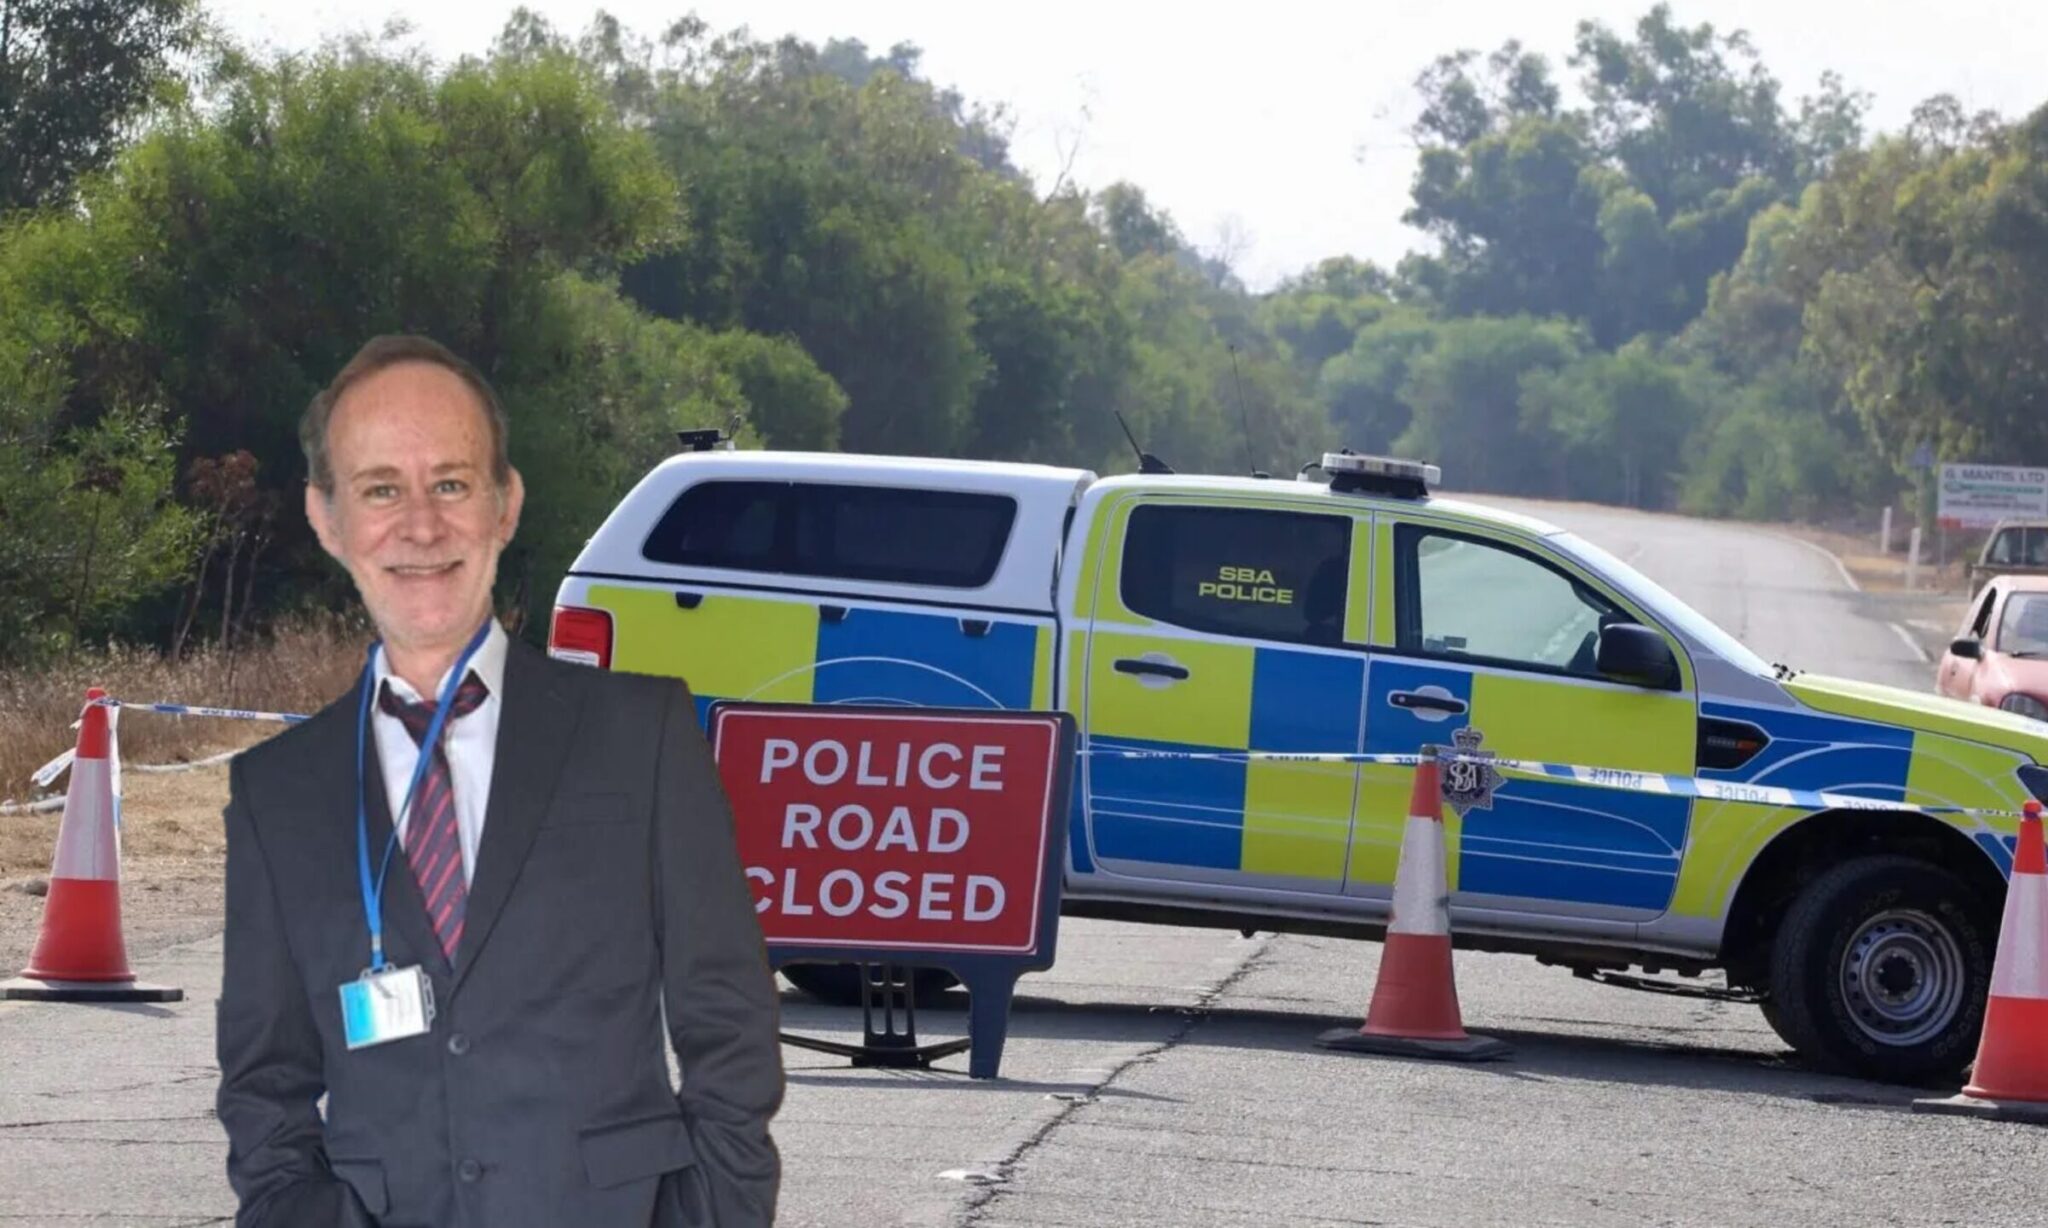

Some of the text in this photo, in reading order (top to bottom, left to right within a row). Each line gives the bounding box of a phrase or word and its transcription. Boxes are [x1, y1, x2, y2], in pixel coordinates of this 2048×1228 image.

[2019, 471, 2046, 483] LTD
[1218, 566, 1275, 585] SBA
[1198, 582, 1293, 604] POLICE
[759, 738, 1006, 791] POLICE
[1588, 767, 1643, 789] POLICE
[781, 804, 970, 854] ROAD
[744, 866, 1006, 922] CLOSED
